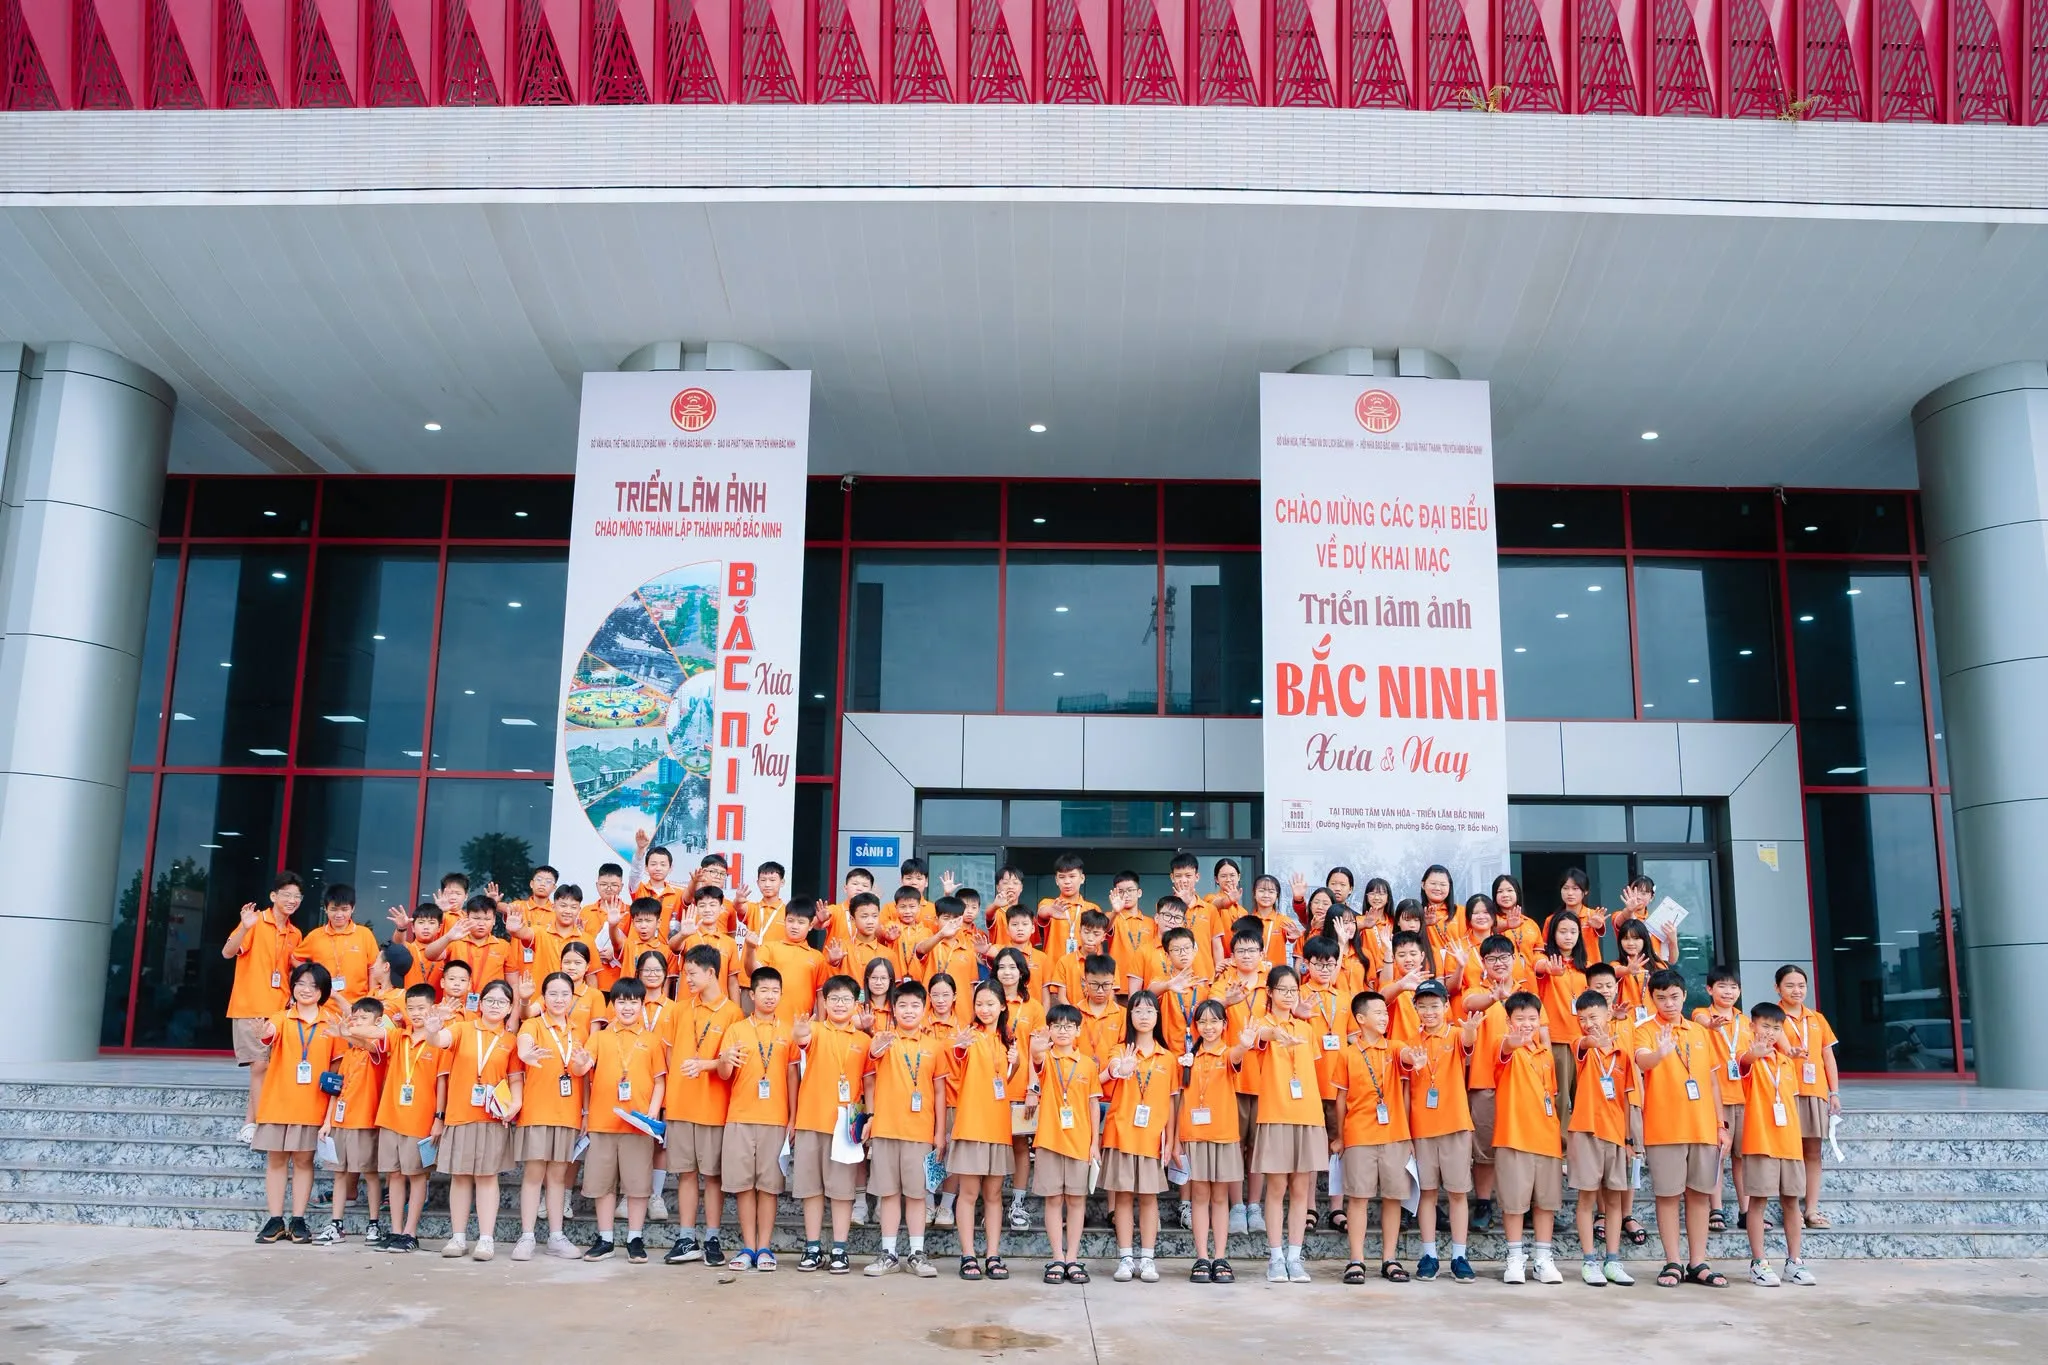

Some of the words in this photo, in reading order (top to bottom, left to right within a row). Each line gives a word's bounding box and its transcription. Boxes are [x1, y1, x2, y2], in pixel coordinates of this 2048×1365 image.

[615, 469, 672, 512] TRIỂN
[678, 476, 720, 512] LÃM
[726, 472, 766, 513] ẢNH
[595, 517, 618, 536] CHÀO
[620, 517, 642, 537] MỪNG
[645, 517, 673, 537] THÀNH
[674, 517, 692, 542] LẬP
[694, 518, 722, 538] THÀNH
[724, 516, 742, 538] PHỐ
[742, 515, 760, 538] BẮC
[762, 522, 782, 538] NINH
[1276, 493, 1322, 524] CHÀO
[1327, 495, 1374, 526] MỪNG
[1380, 496, 1414, 528] CÁC
[1419, 504, 1446, 534] ĐẠI
[1452, 493, 1488, 531] BIỂU
[1316, 534, 1338, 568] VỀ
[1344, 542, 1366, 574] DỰ
[1372, 546, 1409, 570] KHAI
[1415, 547, 1450, 576] MẠC
[1298, 590, 1368, 626] Triển
[1375, 595, 1420, 628] lãm
[1427, 595, 1472, 630] ảnh
[754, 662, 794, 695] Xưa
[1276, 633, 1367, 718] BẮC
[1378, 665, 1498, 721] NINH
[763, 703, 779, 736] &
[752, 743, 790, 787] Nay
[1306, 733, 1374, 772] Xưa
[1380, 746, 1395, 772] &
[1402, 735, 1472, 782] Nay
[1342, 808, 1364, 816] TRUNG
[1366, 807, 1380, 816] TÂM
[1417, 807, 1436, 818] TRIỂN
[1468, 811, 1485, 819] NINH
[1395, 822, 1420, 832] phường
[1481, 824, 1498, 833] Ninh)
[886, 846, 894, 857] B
